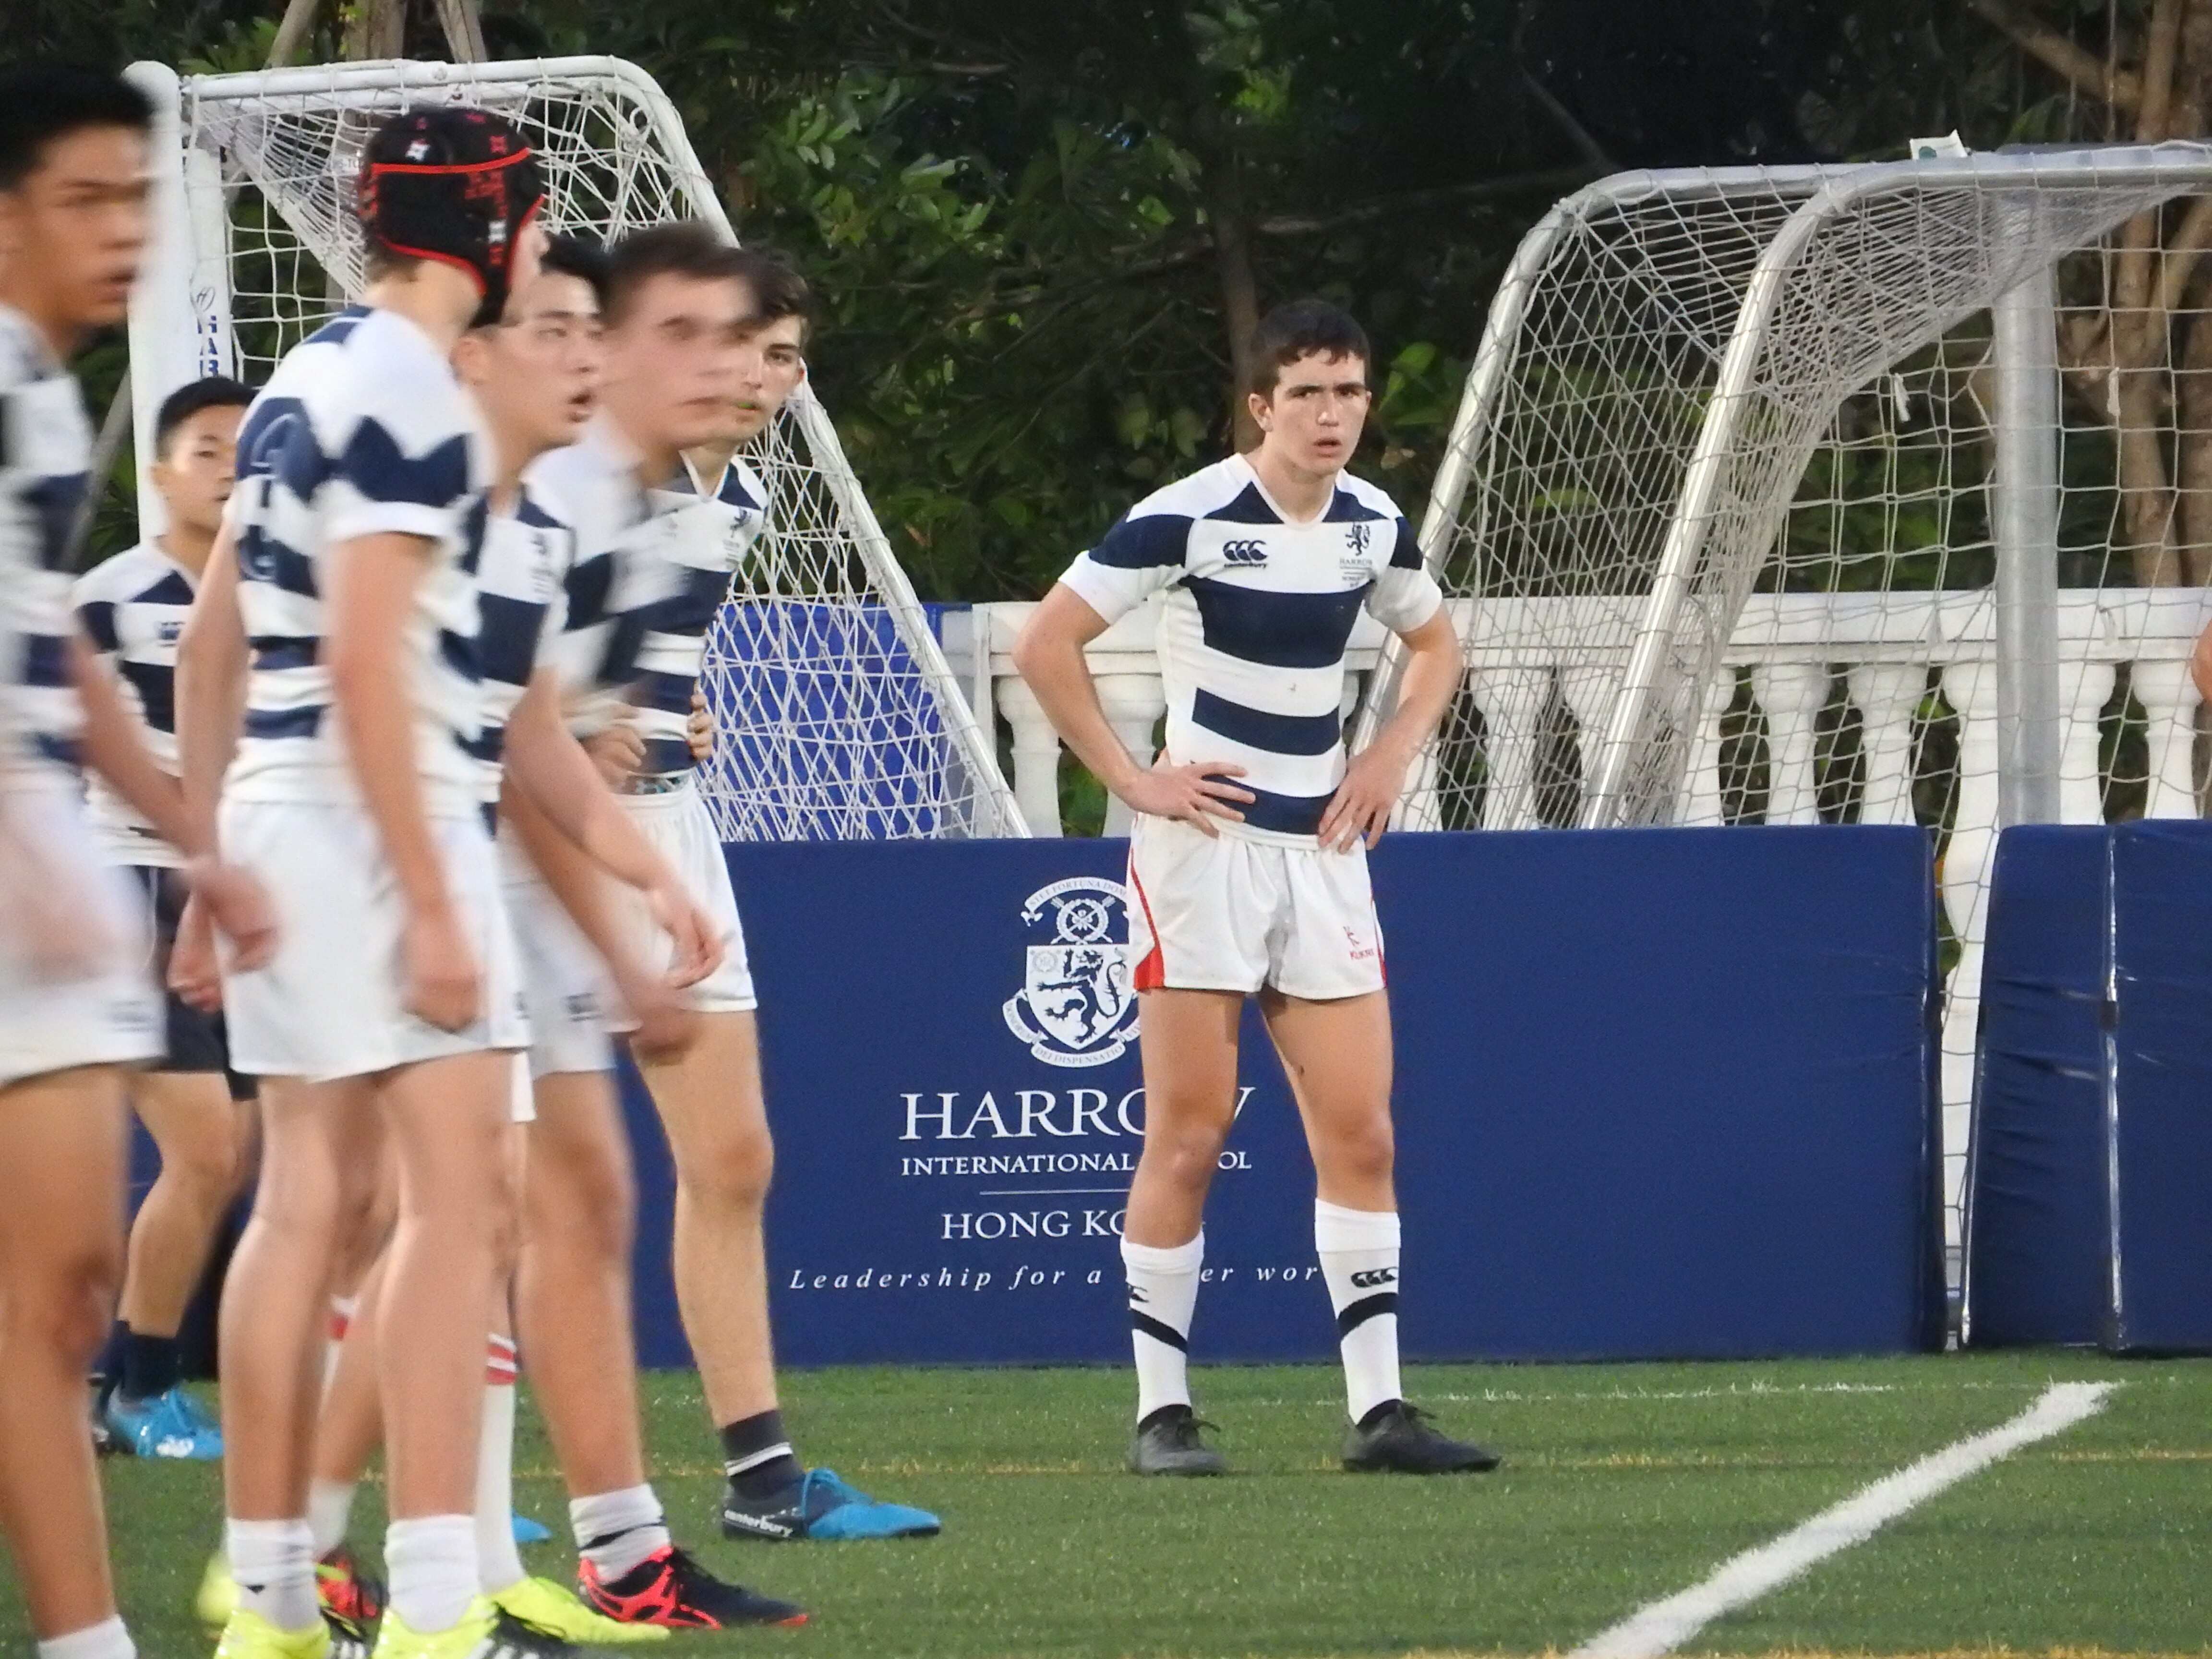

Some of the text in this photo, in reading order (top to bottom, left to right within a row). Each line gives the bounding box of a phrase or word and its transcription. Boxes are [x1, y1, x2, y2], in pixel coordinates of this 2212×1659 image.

[899, 1087, 1255, 1140] HARRO
[902, 1154, 1135, 1176] INTERNATIONAL
[942, 1211, 1070, 1238] HONG
[789, 1266, 1317, 1291] Leadership for a wor
